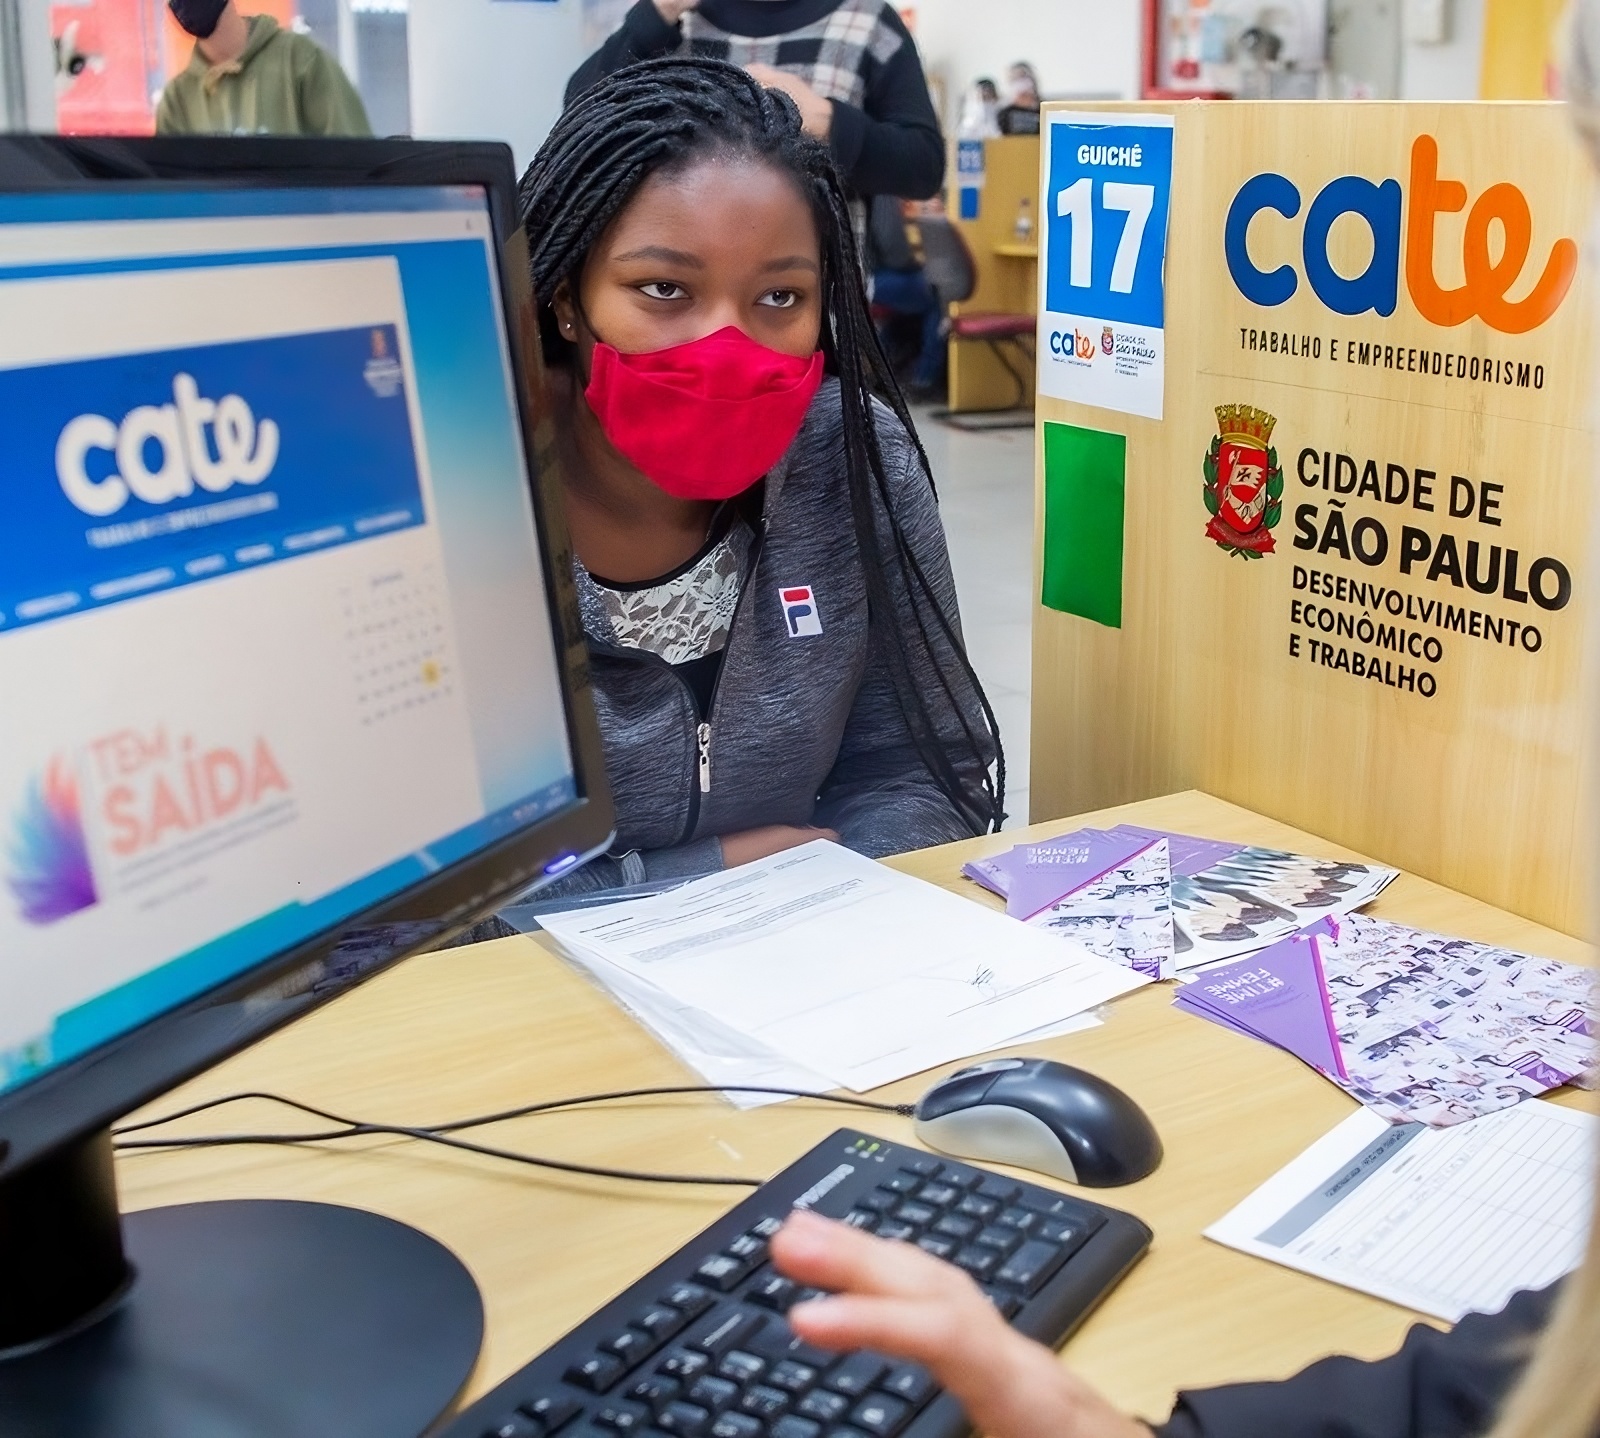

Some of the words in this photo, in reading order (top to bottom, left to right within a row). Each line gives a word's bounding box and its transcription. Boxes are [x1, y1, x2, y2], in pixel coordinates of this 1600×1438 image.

[1077, 143, 1142, 168] GUICHÊ
[1057, 177, 1155, 294] 17
[1224, 133, 1578, 335] cate
[1050, 327, 1095, 361] cate
[1240, 328, 1321, 358] TRABALHO
[1330, 339, 1338, 361] E
[1347, 341, 1545, 389] EMPREENDEDORISMO
[55, 371, 281, 517] cate
[1296, 447, 1437, 513] CIDADE
[1448, 475, 1505, 527] DE
[1292, 498, 1389, 567] SÃO
[1399, 524, 1572, 612] PAULO
[1290, 600, 1443, 663] ECONÔMICO
[1292, 565, 1543, 653] DESENVOLVIMENTO
[1289, 633, 1300, 658] E
[1307, 637, 1437, 698] TRABALHO
[102, 733, 293, 857] SAÍDA
[1203, 967, 1272, 997] FEMME
[1216, 976, 1285, 1005] #TIME
